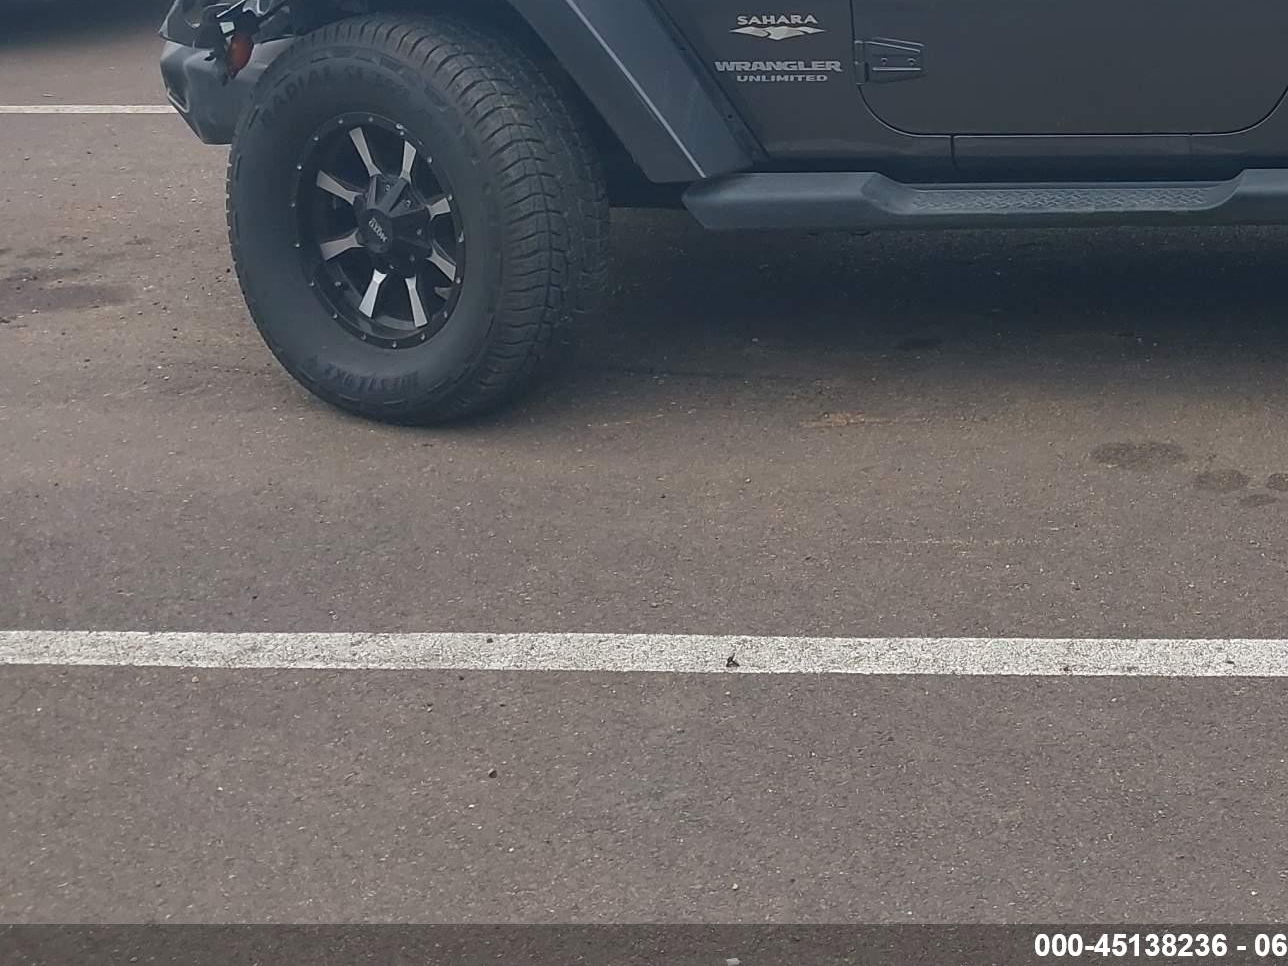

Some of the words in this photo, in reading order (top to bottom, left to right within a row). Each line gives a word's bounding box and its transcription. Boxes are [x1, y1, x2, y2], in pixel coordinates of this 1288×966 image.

[737, 14, 818, 25] SAHARA
[714, 60, 843, 72] WRANGLER
[736, 74, 828, 82] UNLIMITED
